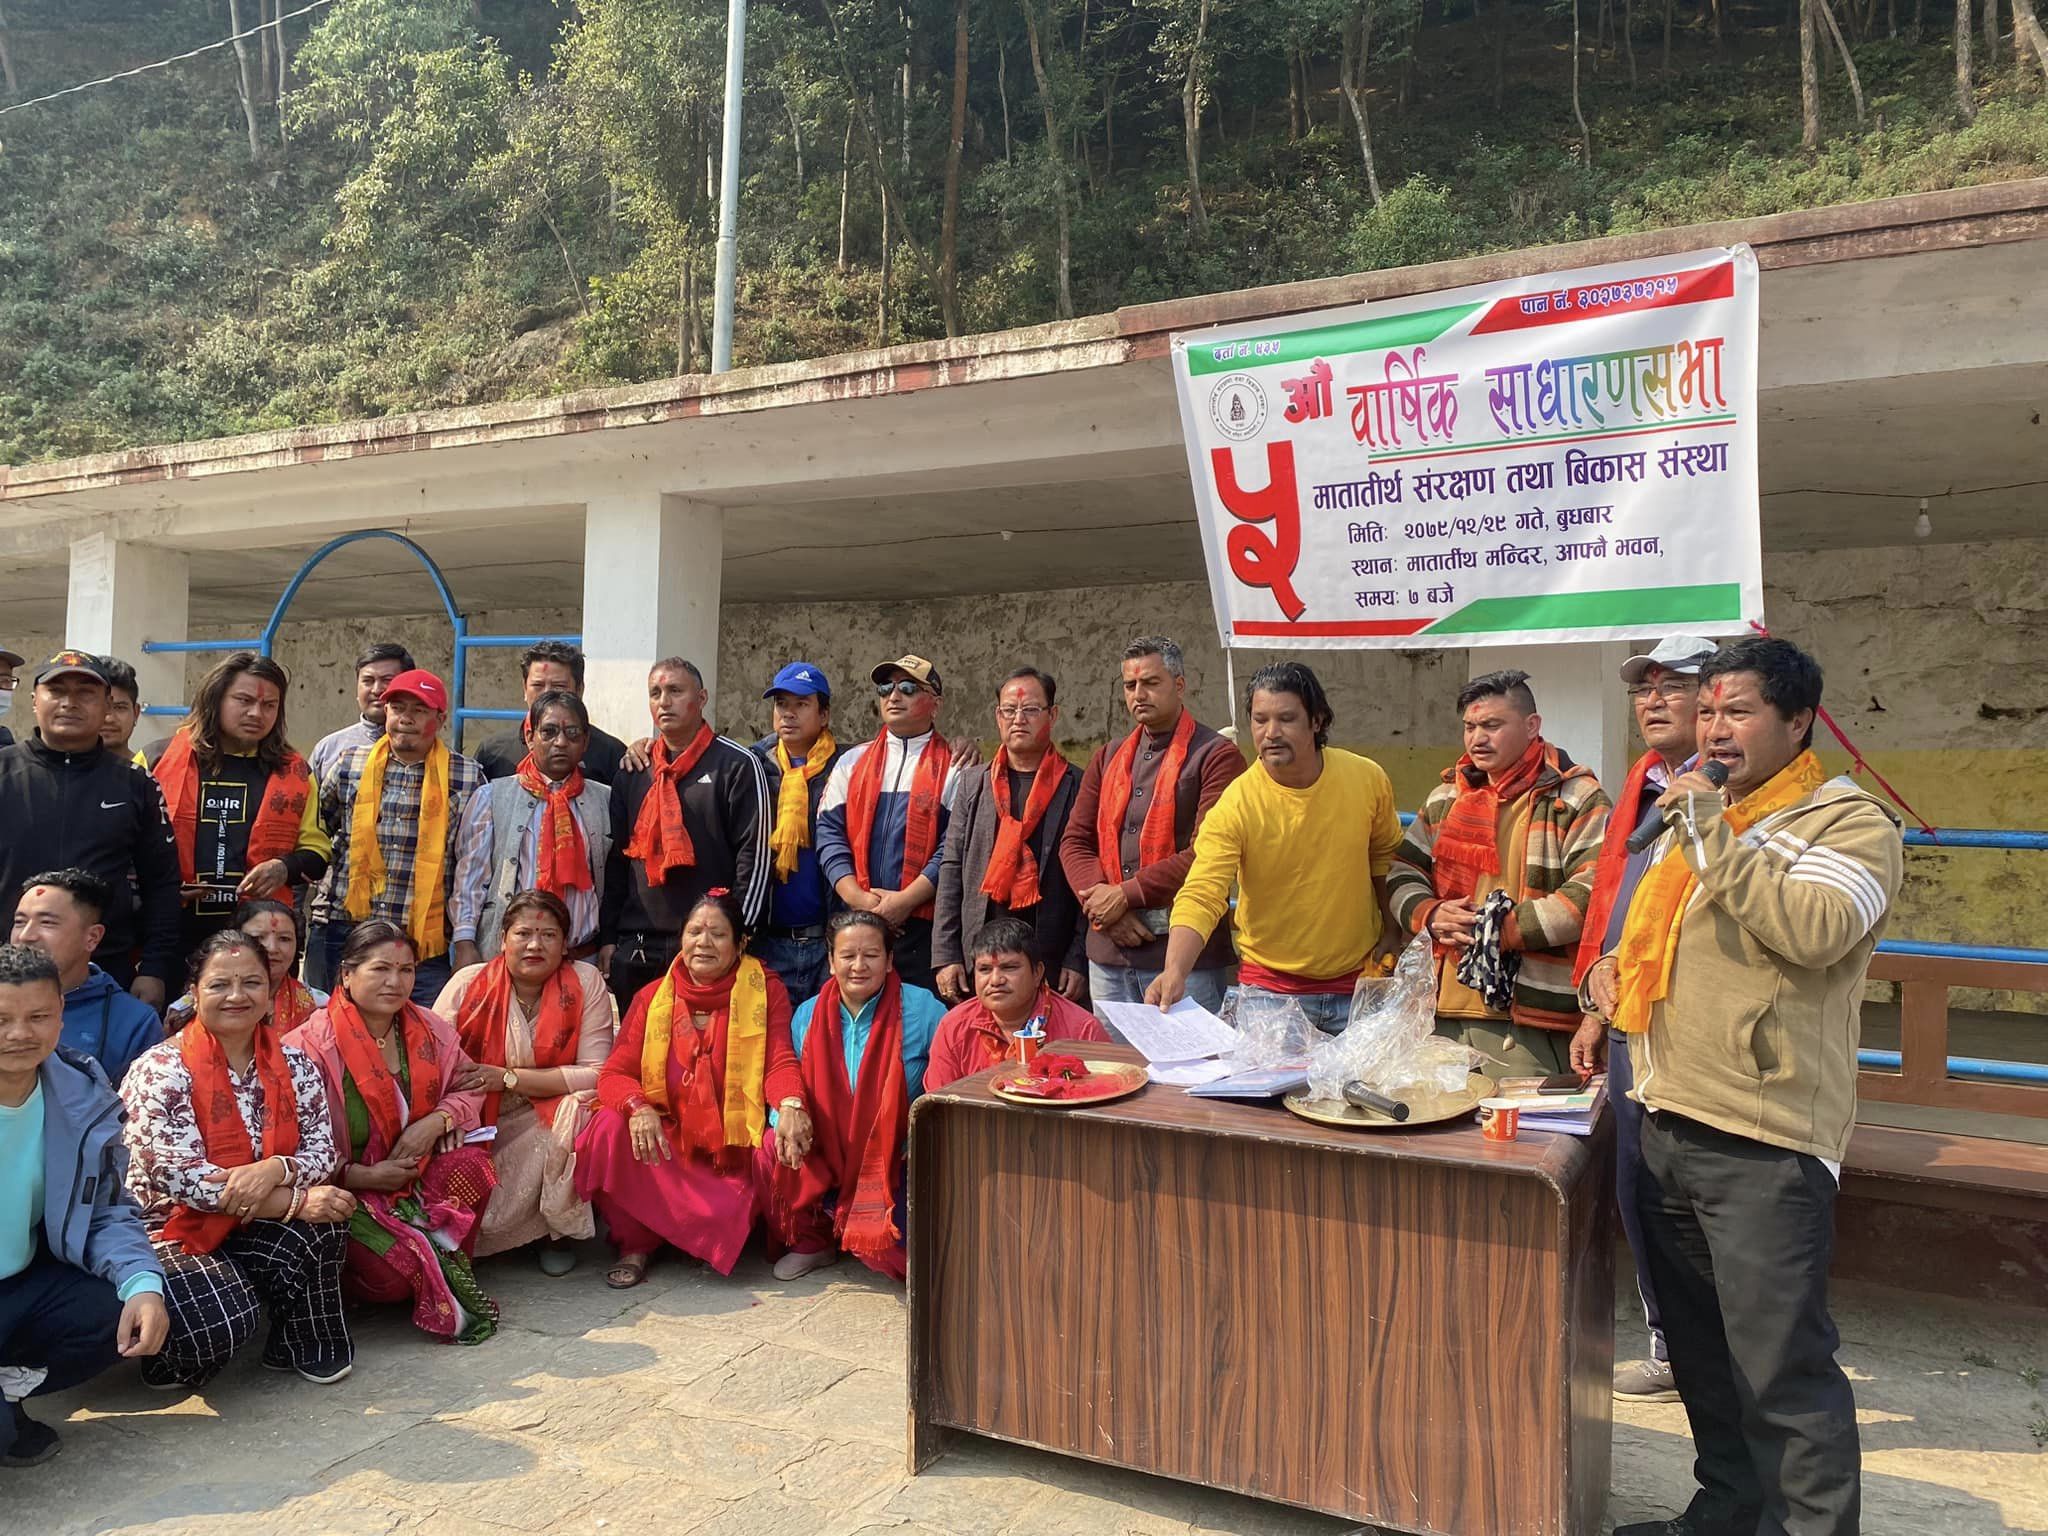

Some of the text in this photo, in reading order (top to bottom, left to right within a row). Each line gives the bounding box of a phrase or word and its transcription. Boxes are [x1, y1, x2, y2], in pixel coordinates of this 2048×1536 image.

[1521, 296, 1549, 314] पान
[1347, 347, 1458, 448] वार्षिक
[1485, 337, 1727, 438] साधारणसभा
[1313, 440, 1729, 510] मातातीर्थ संरक्षण तथा बिकास संस्था
[1211, 440, 1306, 623] ५
[1404, 513, 1507, 539] २०७९/१२/२९
[1515, 507, 1549, 532] गते,
[1556, 505, 1614, 532] बुधबार
[1486, 543, 1548, 567] मन्दिर,
[1615, 536, 1664, 558] भवन,
[1408, 589, 1419, 605] ७
[1426, 582, 1455, 604] बजे
